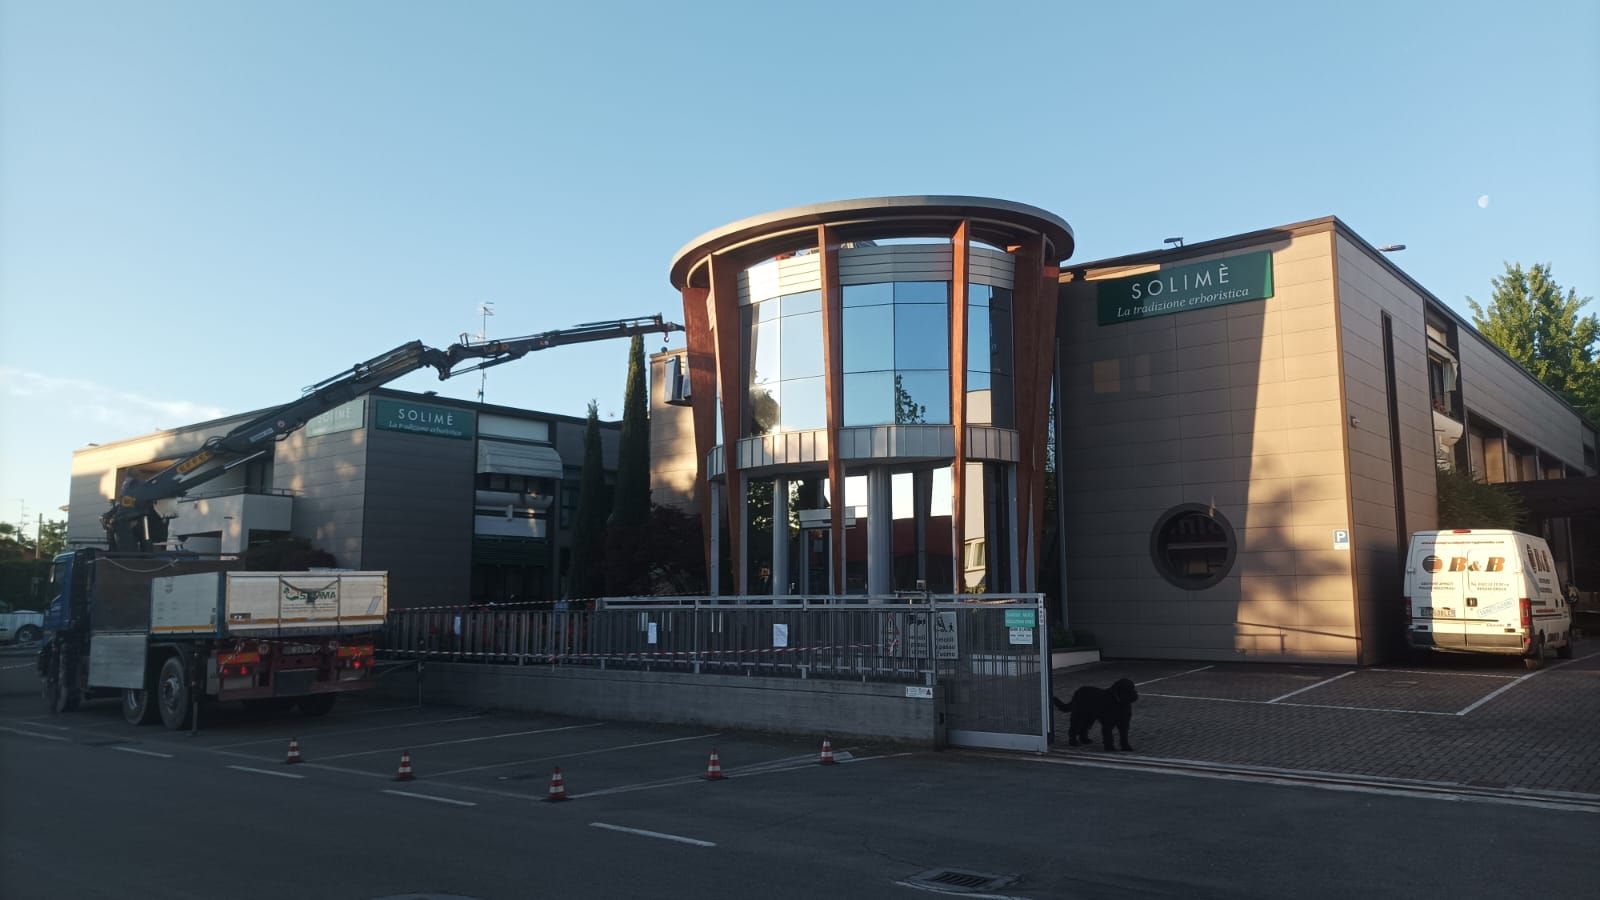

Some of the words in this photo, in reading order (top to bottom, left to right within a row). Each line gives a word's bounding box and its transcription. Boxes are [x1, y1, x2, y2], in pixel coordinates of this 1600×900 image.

[1131, 263, 1230, 299] SOLIMÈ
[1117, 306, 1131, 318] La
[1133, 298, 1186, 315] tradizione
[1189, 287, 1249, 306] erboristica
[1337, 531, 1346, 542] P
[1449, 556, 1467, 572] B
[1486, 556, 1505, 572] B
